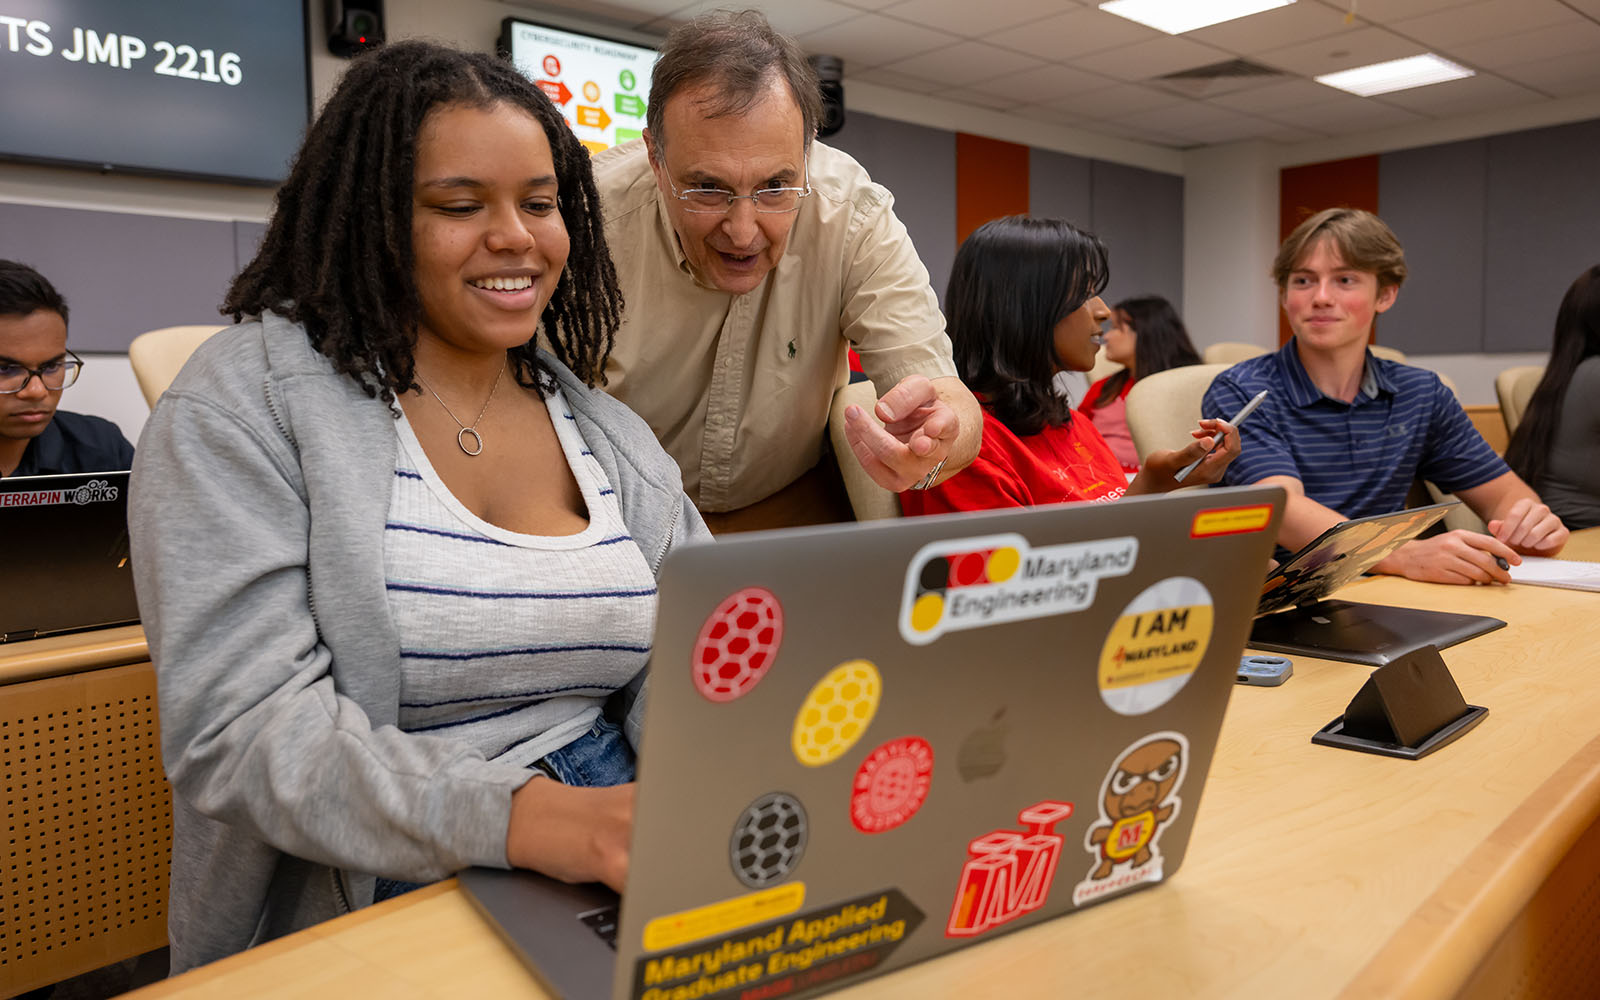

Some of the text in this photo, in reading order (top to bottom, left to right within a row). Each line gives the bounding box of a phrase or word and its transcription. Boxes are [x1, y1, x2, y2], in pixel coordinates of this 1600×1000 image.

[0, 15, 242, 85] TS JMP 2216
[0, 487, 117, 506] TERRAPIN WORKS
[1089, 487, 1126, 504] mes
[1022, 548, 1133, 581] Maryland
[951, 581, 1090, 618] Engineering
[1131, 608, 1190, 639] I AM
[1117, 820, 1145, 850] M
[644, 926, 784, 986] Maryland
[787, 896, 888, 944] Applied
[641, 963, 763, 1000] Graduate
[768, 920, 906, 975] Engineering
